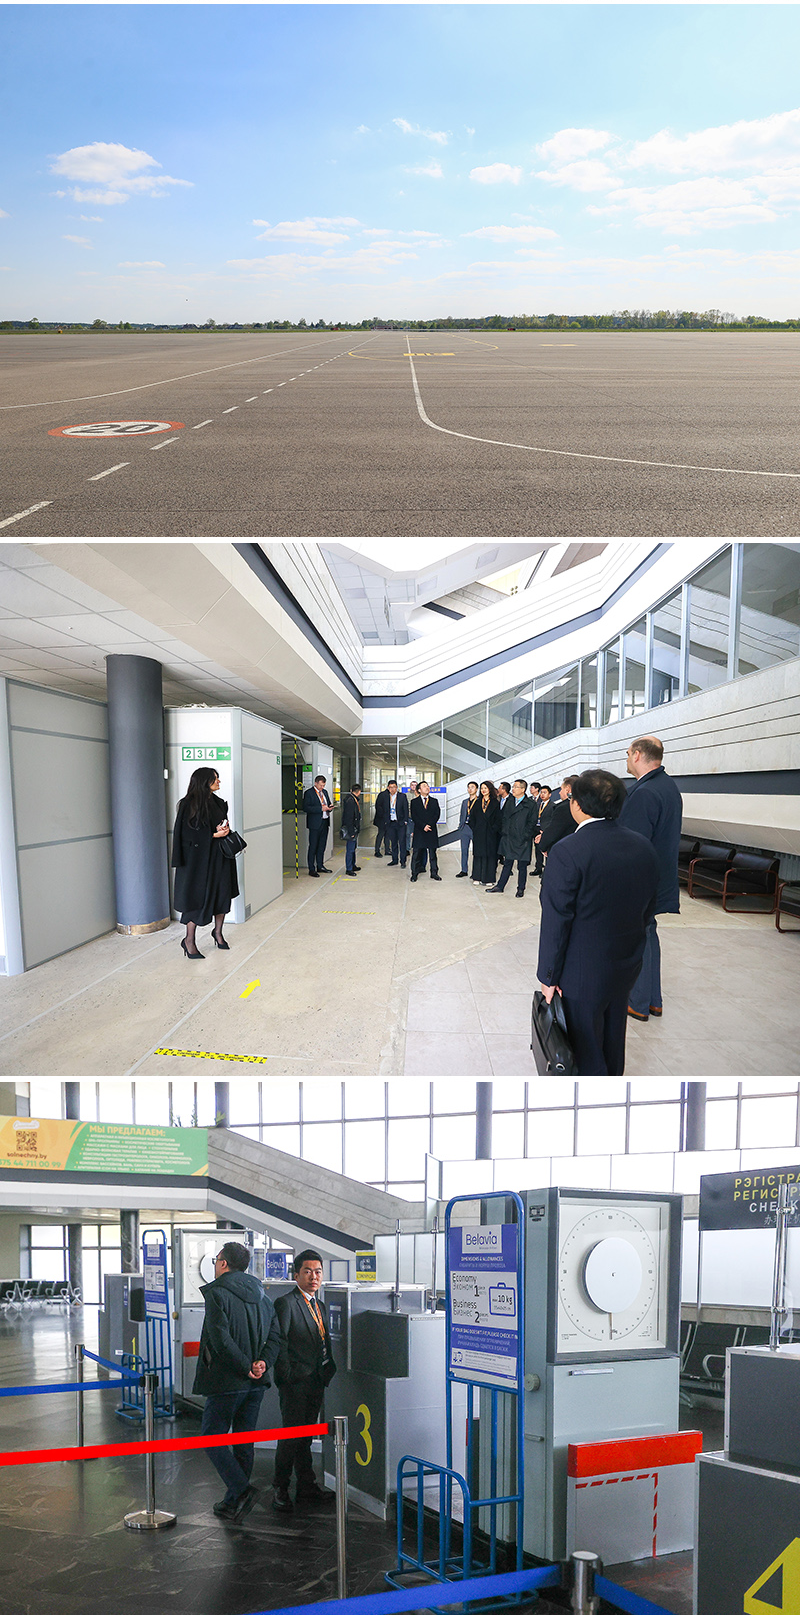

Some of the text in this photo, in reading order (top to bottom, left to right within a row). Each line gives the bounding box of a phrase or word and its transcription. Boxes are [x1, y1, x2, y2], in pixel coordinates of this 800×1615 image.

[70, 424, 159, 433] 20
[185, 750, 214, 758] 2 3 4
[90, 1125, 166, 1137] МЫ ПРЕДЛАГАЕМ:
[749, 1200, 798, 1212] CHEK
[466, 1231, 497, 1245] Belavia
[267, 1258, 284, 1269] Belavia
[452, 1273, 477, 1284] Economy
[474, 1285, 479, 1297] 1
[453, 1299, 477, 1309] Business
[506, 1296, 512, 1305] kg
[474, 1311, 480, 1323] 2
[355, 1404, 372, 1466] 3
